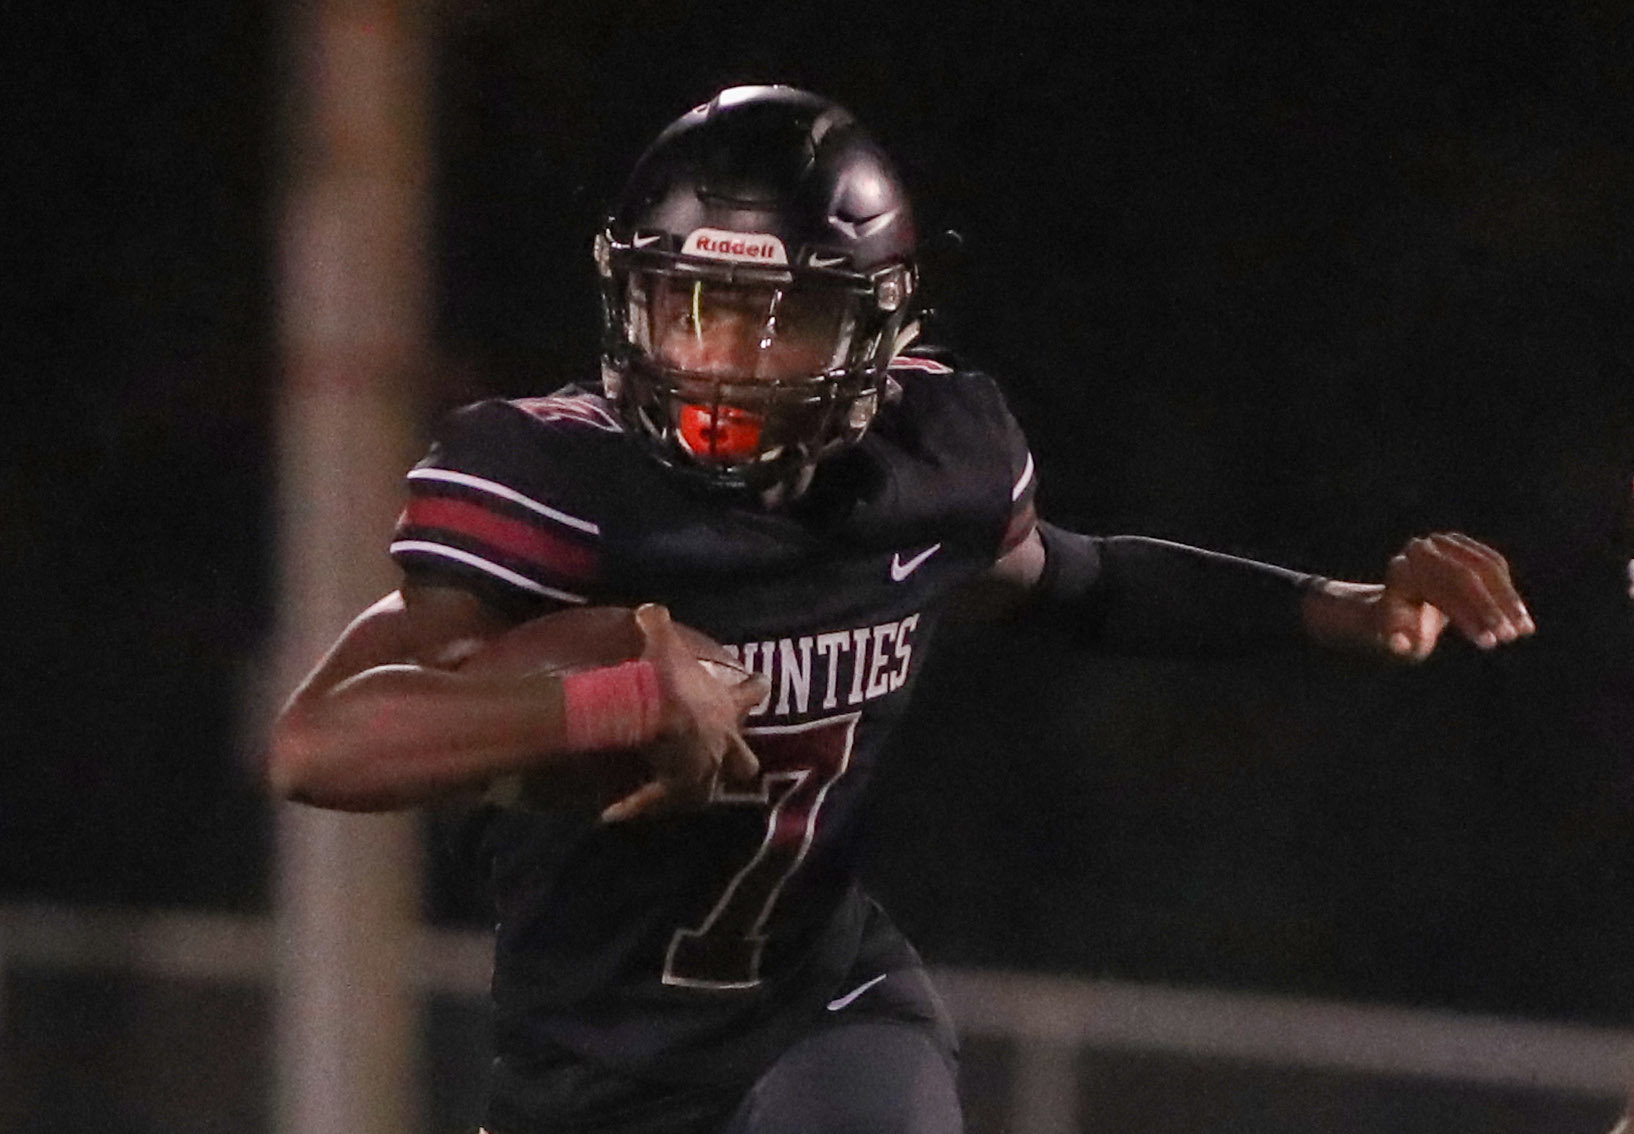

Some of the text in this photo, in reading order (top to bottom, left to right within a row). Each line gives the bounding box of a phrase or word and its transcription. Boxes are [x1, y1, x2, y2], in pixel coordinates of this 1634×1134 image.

[696, 235, 774, 259] Riddell
[723, 613, 920, 717] UNTIES
[662, 710, 862, 989] 7
